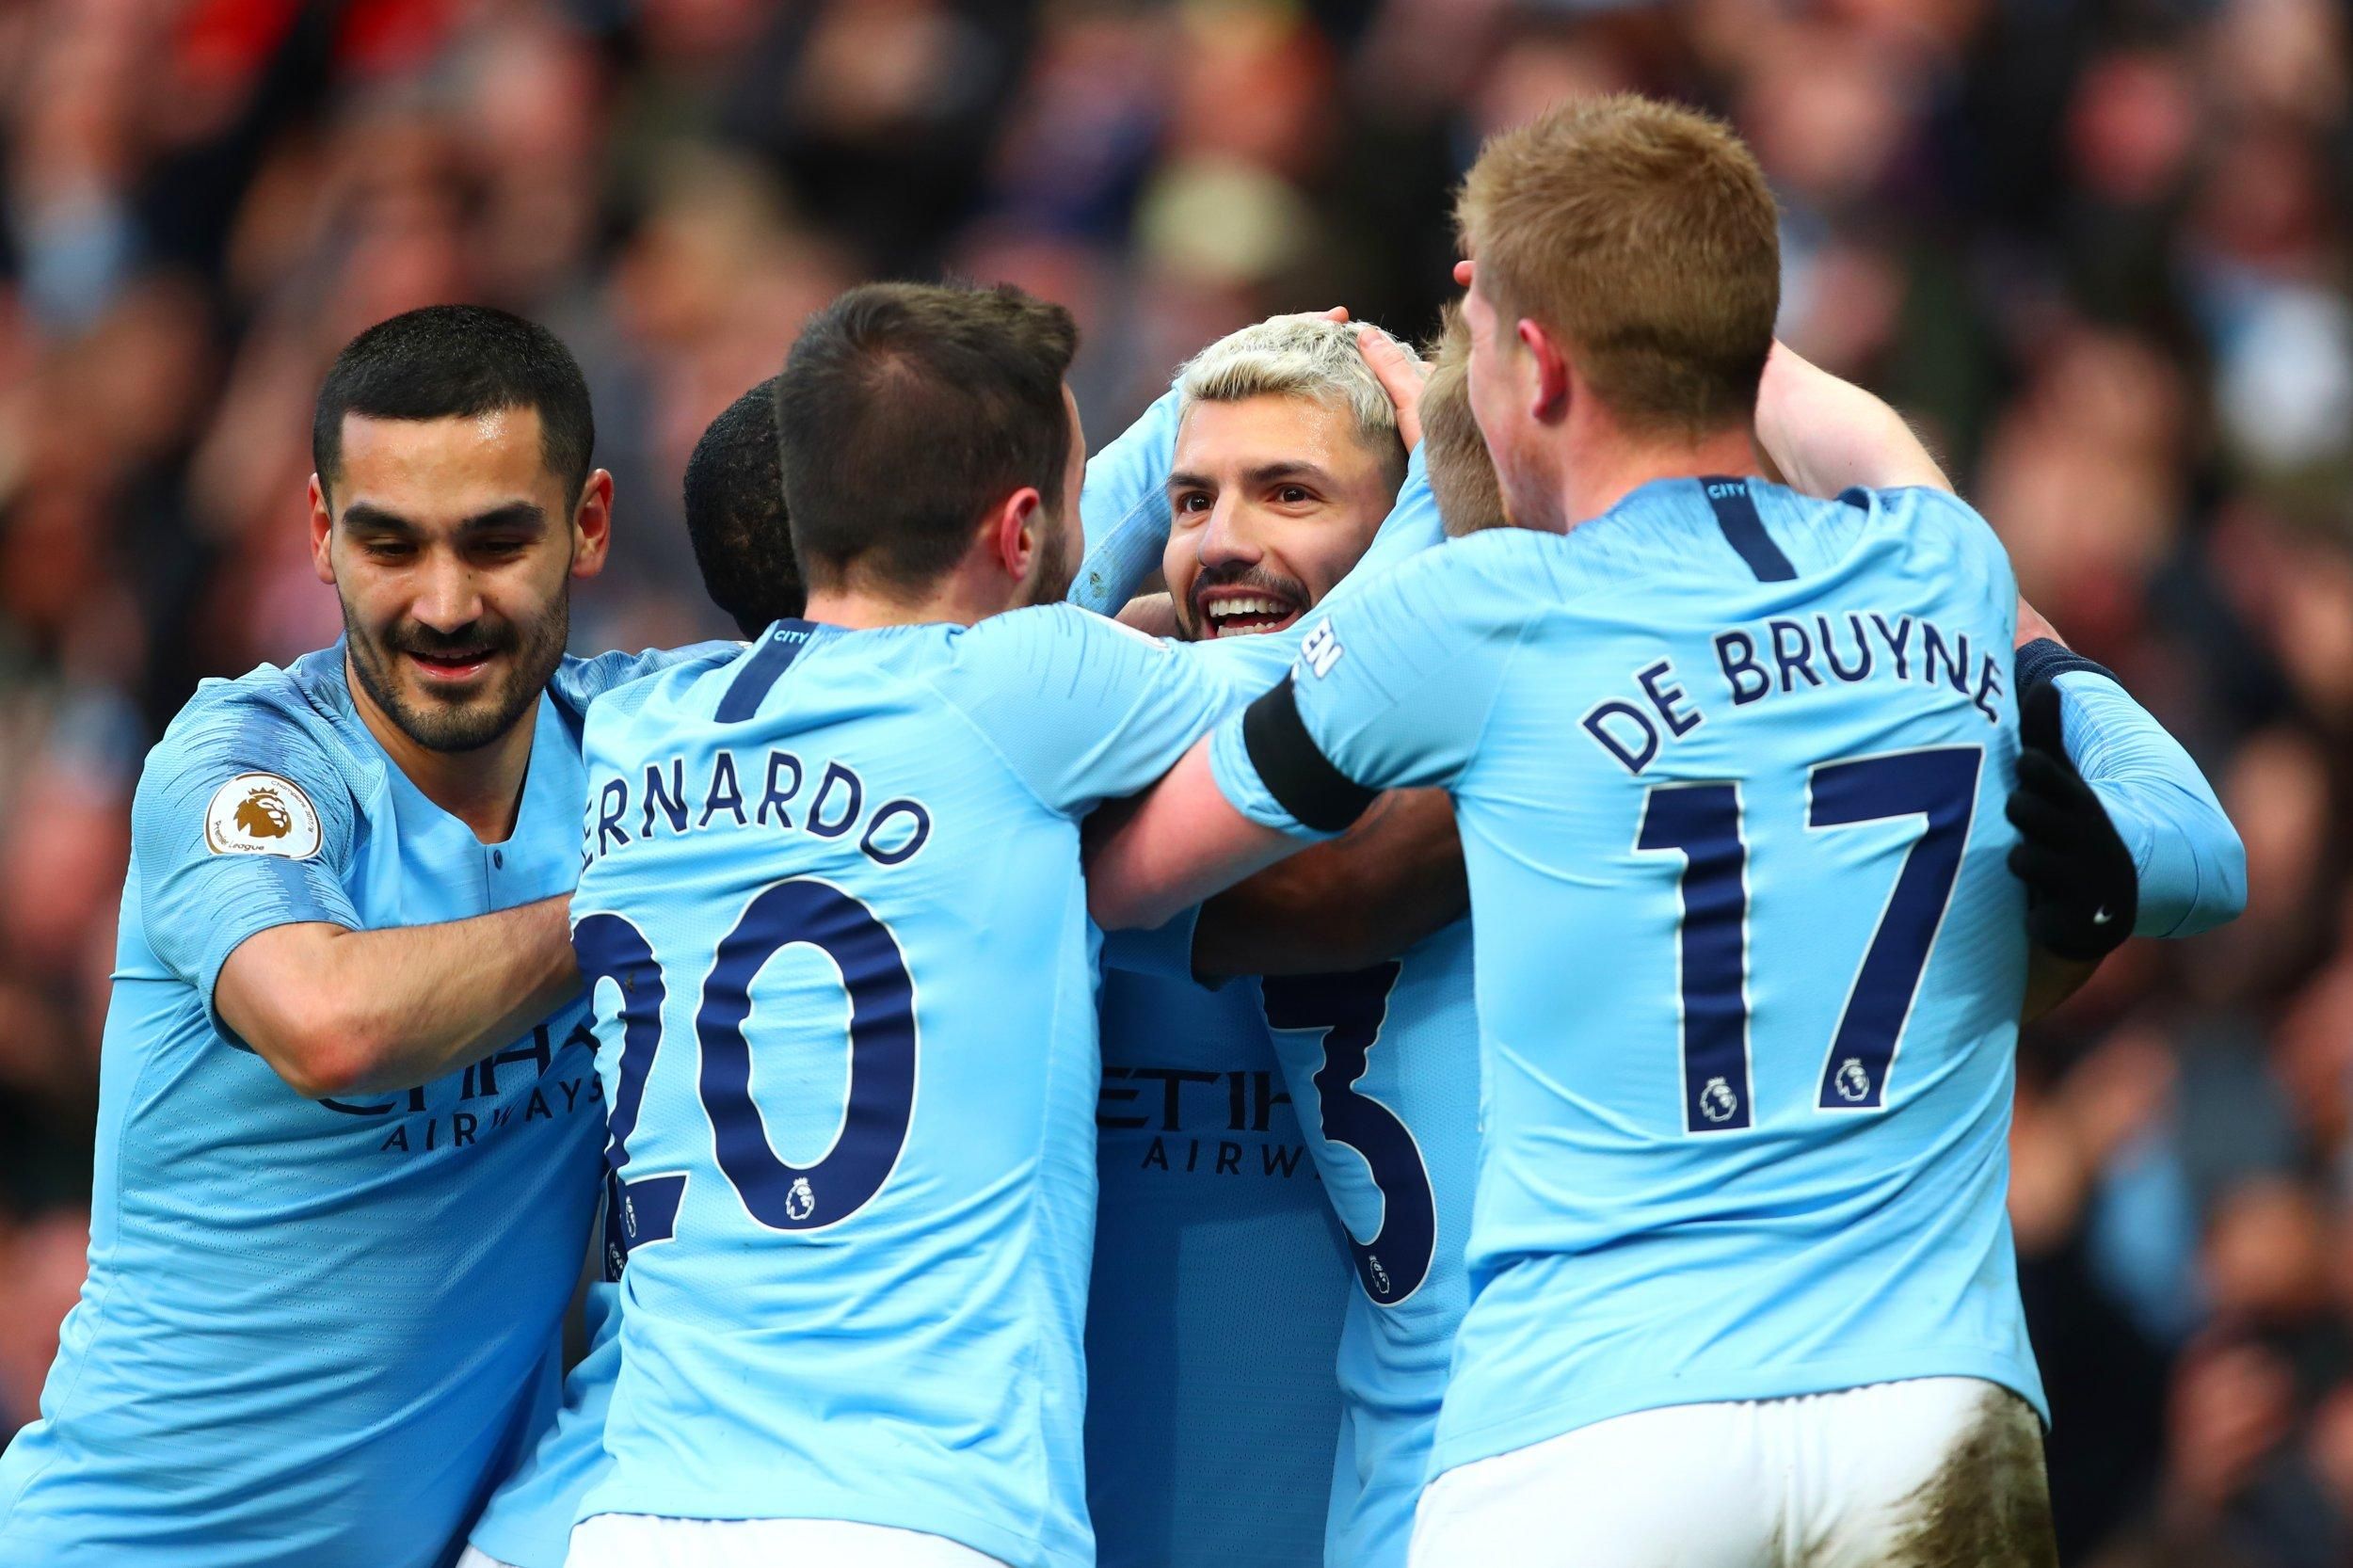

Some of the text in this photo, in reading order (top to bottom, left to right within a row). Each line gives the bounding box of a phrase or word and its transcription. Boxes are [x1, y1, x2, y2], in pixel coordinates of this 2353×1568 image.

[1707, 483, 1746, 499] CITY
[773, 630, 809, 644] CITY
[1290, 615, 1344, 680] EN
[1578, 613, 2005, 776] DE BRUYNE
[1631, 744, 1984, 1133] 17
[1141, 1135, 1321, 1179] AIRW
